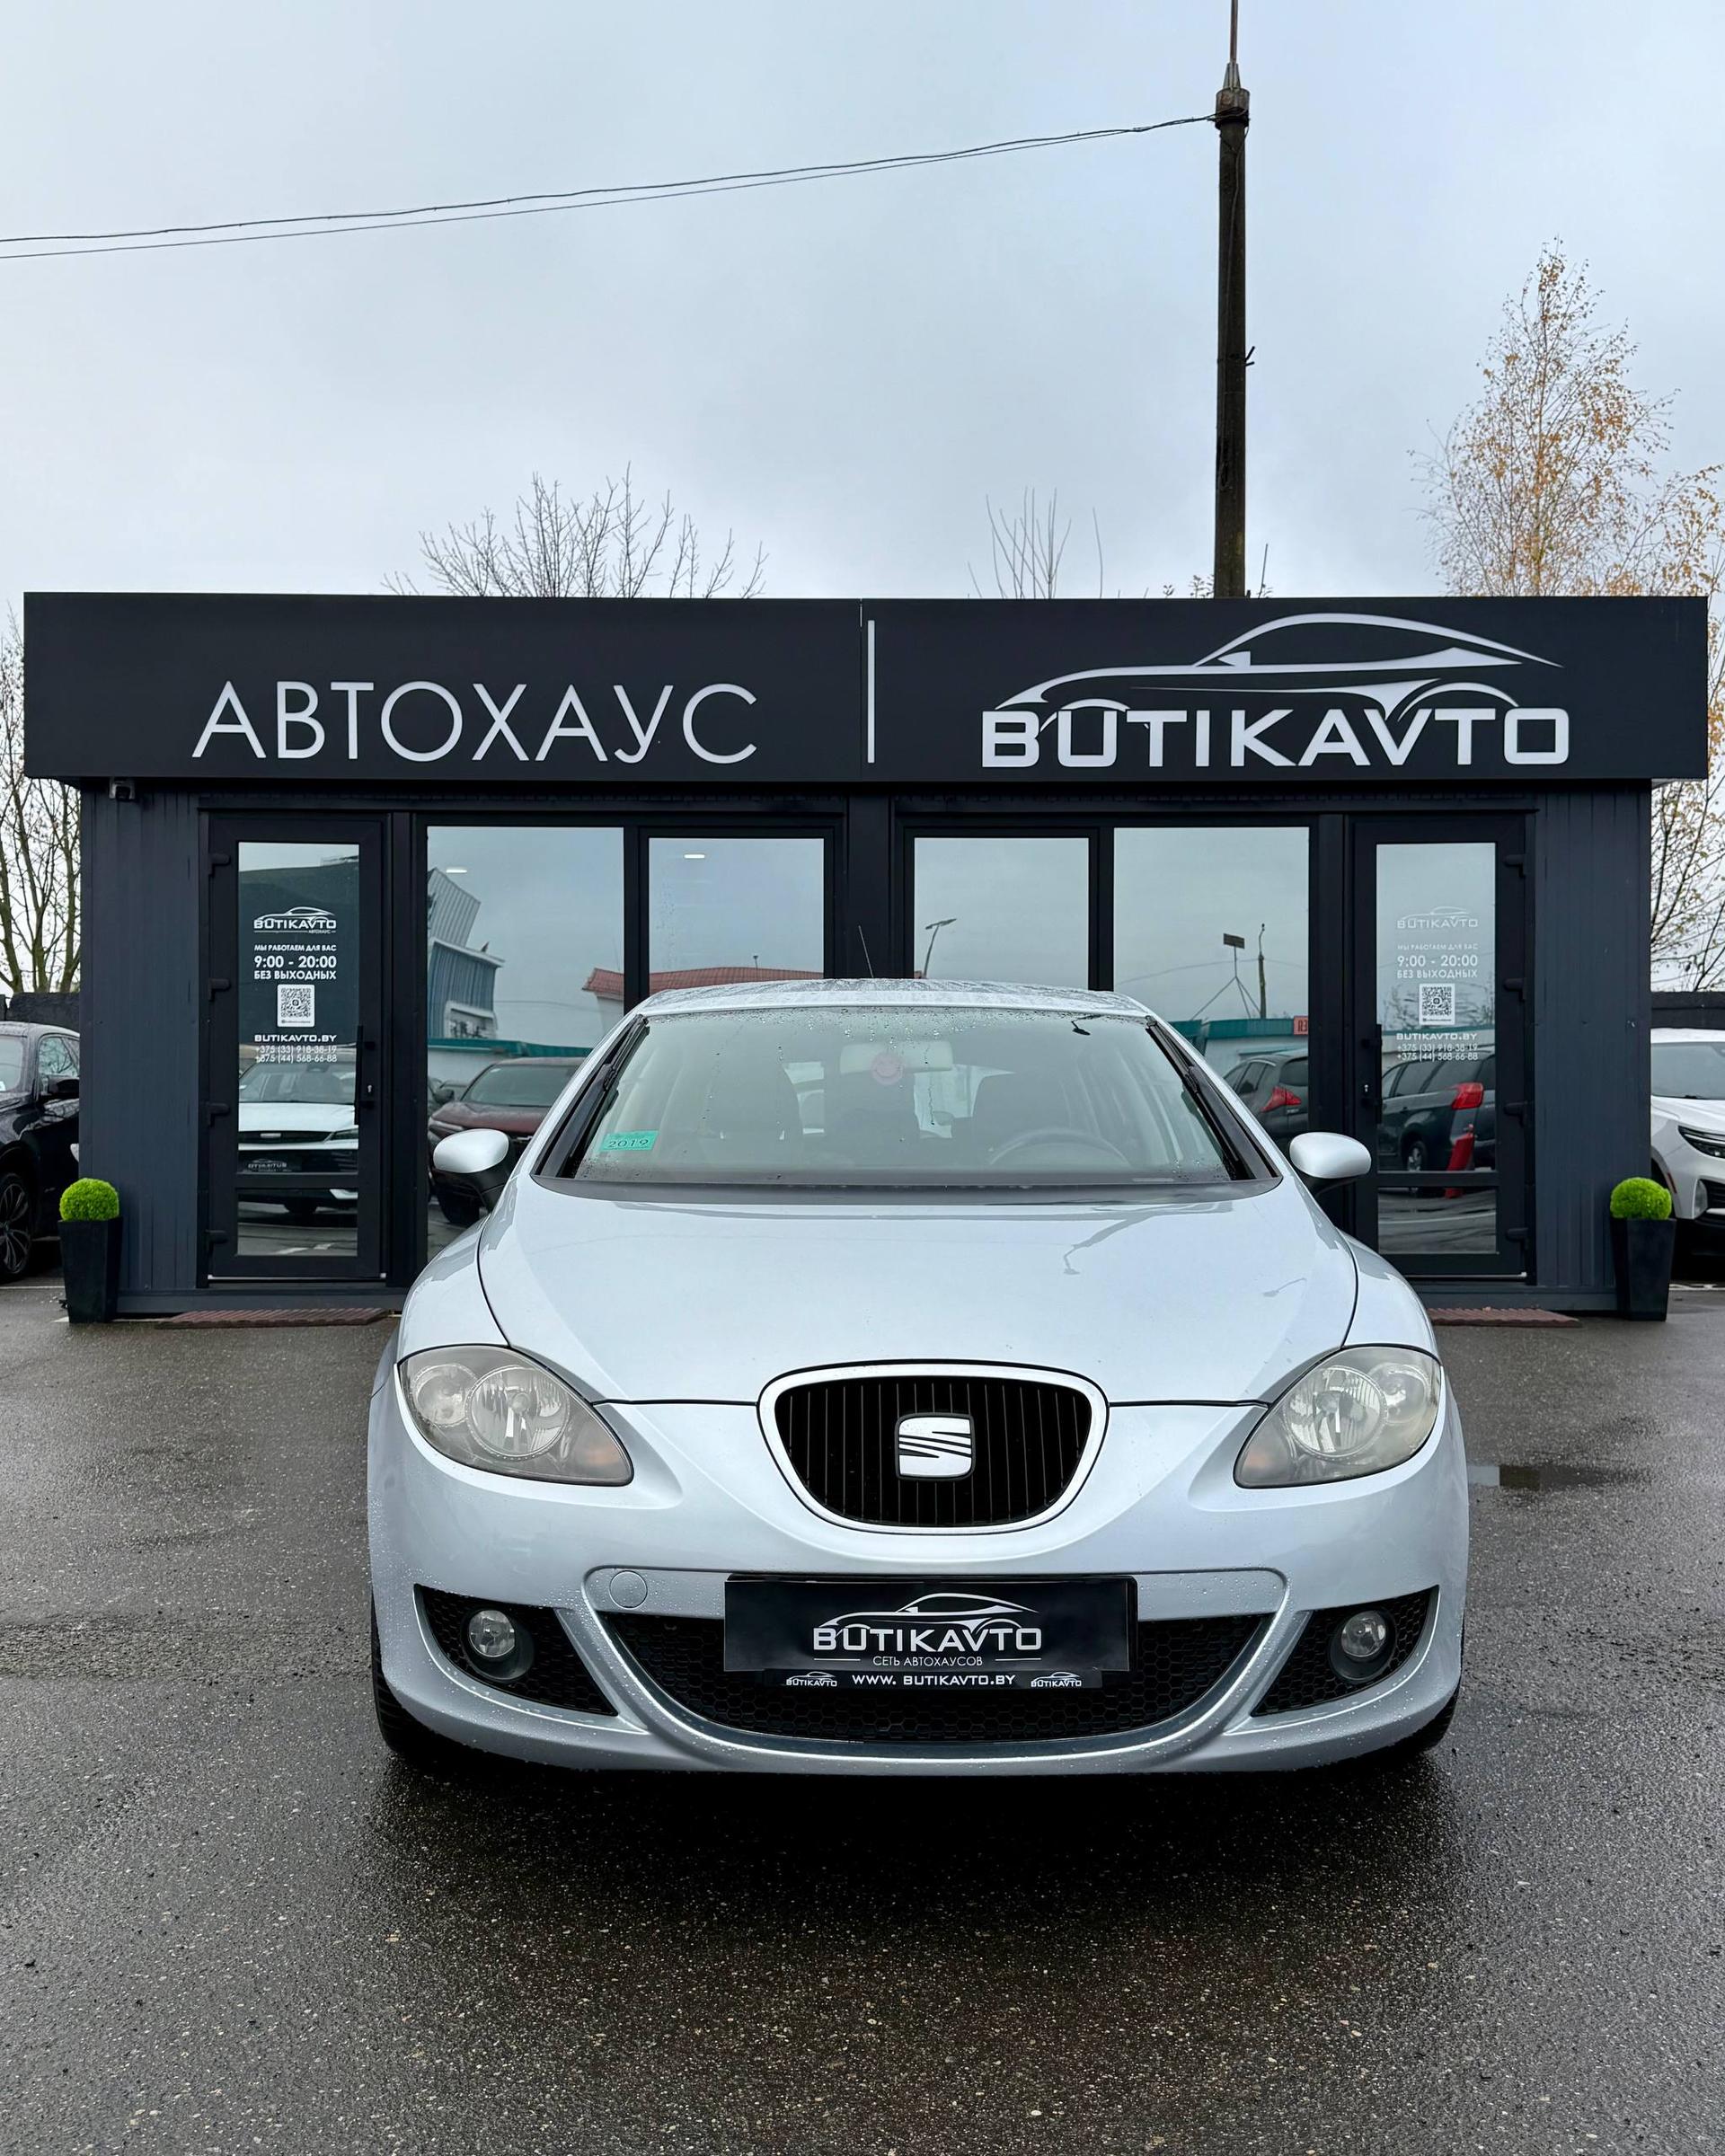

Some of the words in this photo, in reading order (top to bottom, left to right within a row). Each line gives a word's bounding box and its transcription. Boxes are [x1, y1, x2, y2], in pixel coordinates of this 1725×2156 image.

[191, 680, 757, 764] АВТОХАУС
[982, 706, 1570, 768] BUTIKAVTO
[253, 919, 337, 929] BUTIKAVTO
[1397, 918, 1478, 929] BUTIKAVTO
[305, 945, 321, 953] ДЛЯ
[254, 956, 284, 968] 9:00
[298, 956, 337, 968] 20:00
[1397, 955, 1426, 968] 9:00
[1440, 955, 1478, 968] 20:00
[254, 970, 271, 980] БЕЗ
[274, 970, 337, 981] ВЫХОДНЫХ
[1397, 970, 1413, 979] БЕЗ
[1417, 970, 1478, 979] ВЫХОДНЫХ
[254, 1034, 337, 1042] BUTIKAVTO.BY
[1396, 1033, 1478, 1041] BUTIKAVTO.BY
[278, 1045, 294, 1055] (33)
[1397, 1044, 1417, 1052] +375
[1419, 1043, 1435, 1053] (33)
[278, 1054, 294, 1064] (44)
[296, 1054, 338, 1063] 568-66-88
[1397, 1052, 1417, 1061] +375
[1419, 1052, 1435, 1063] (44)
[1438, 1052, 1478, 1061] 568-66-88
[813, 1627, 1042, 1652] BUTIKAVTO
[872, 1656, 900, 1666] СЕТЬ
[903, 1656, 983, 1666] АВТОХАУСОВ
[786, 1678, 837, 1687] BUTIKAVTO
[852, 1674, 897, 1685] WWW.
[903, 1674, 1016, 1685] BUTIKAVTO.BY
